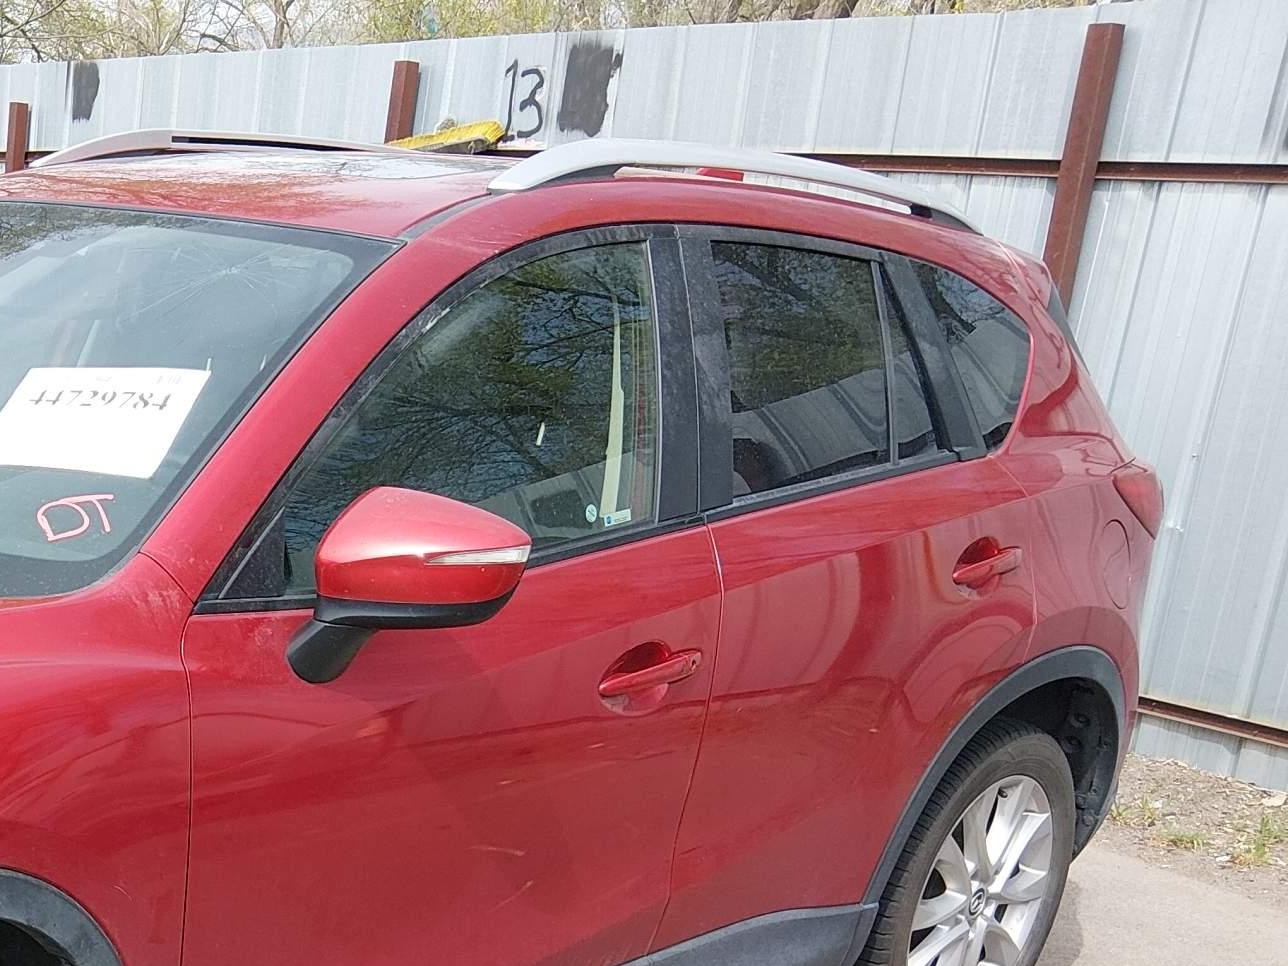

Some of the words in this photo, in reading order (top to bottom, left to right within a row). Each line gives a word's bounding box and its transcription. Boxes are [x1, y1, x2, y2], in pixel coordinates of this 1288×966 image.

[501, 59, 544, 143] 13
[29, 390, 172, 410] 44729784
[36, 493, 115, 542] DT
